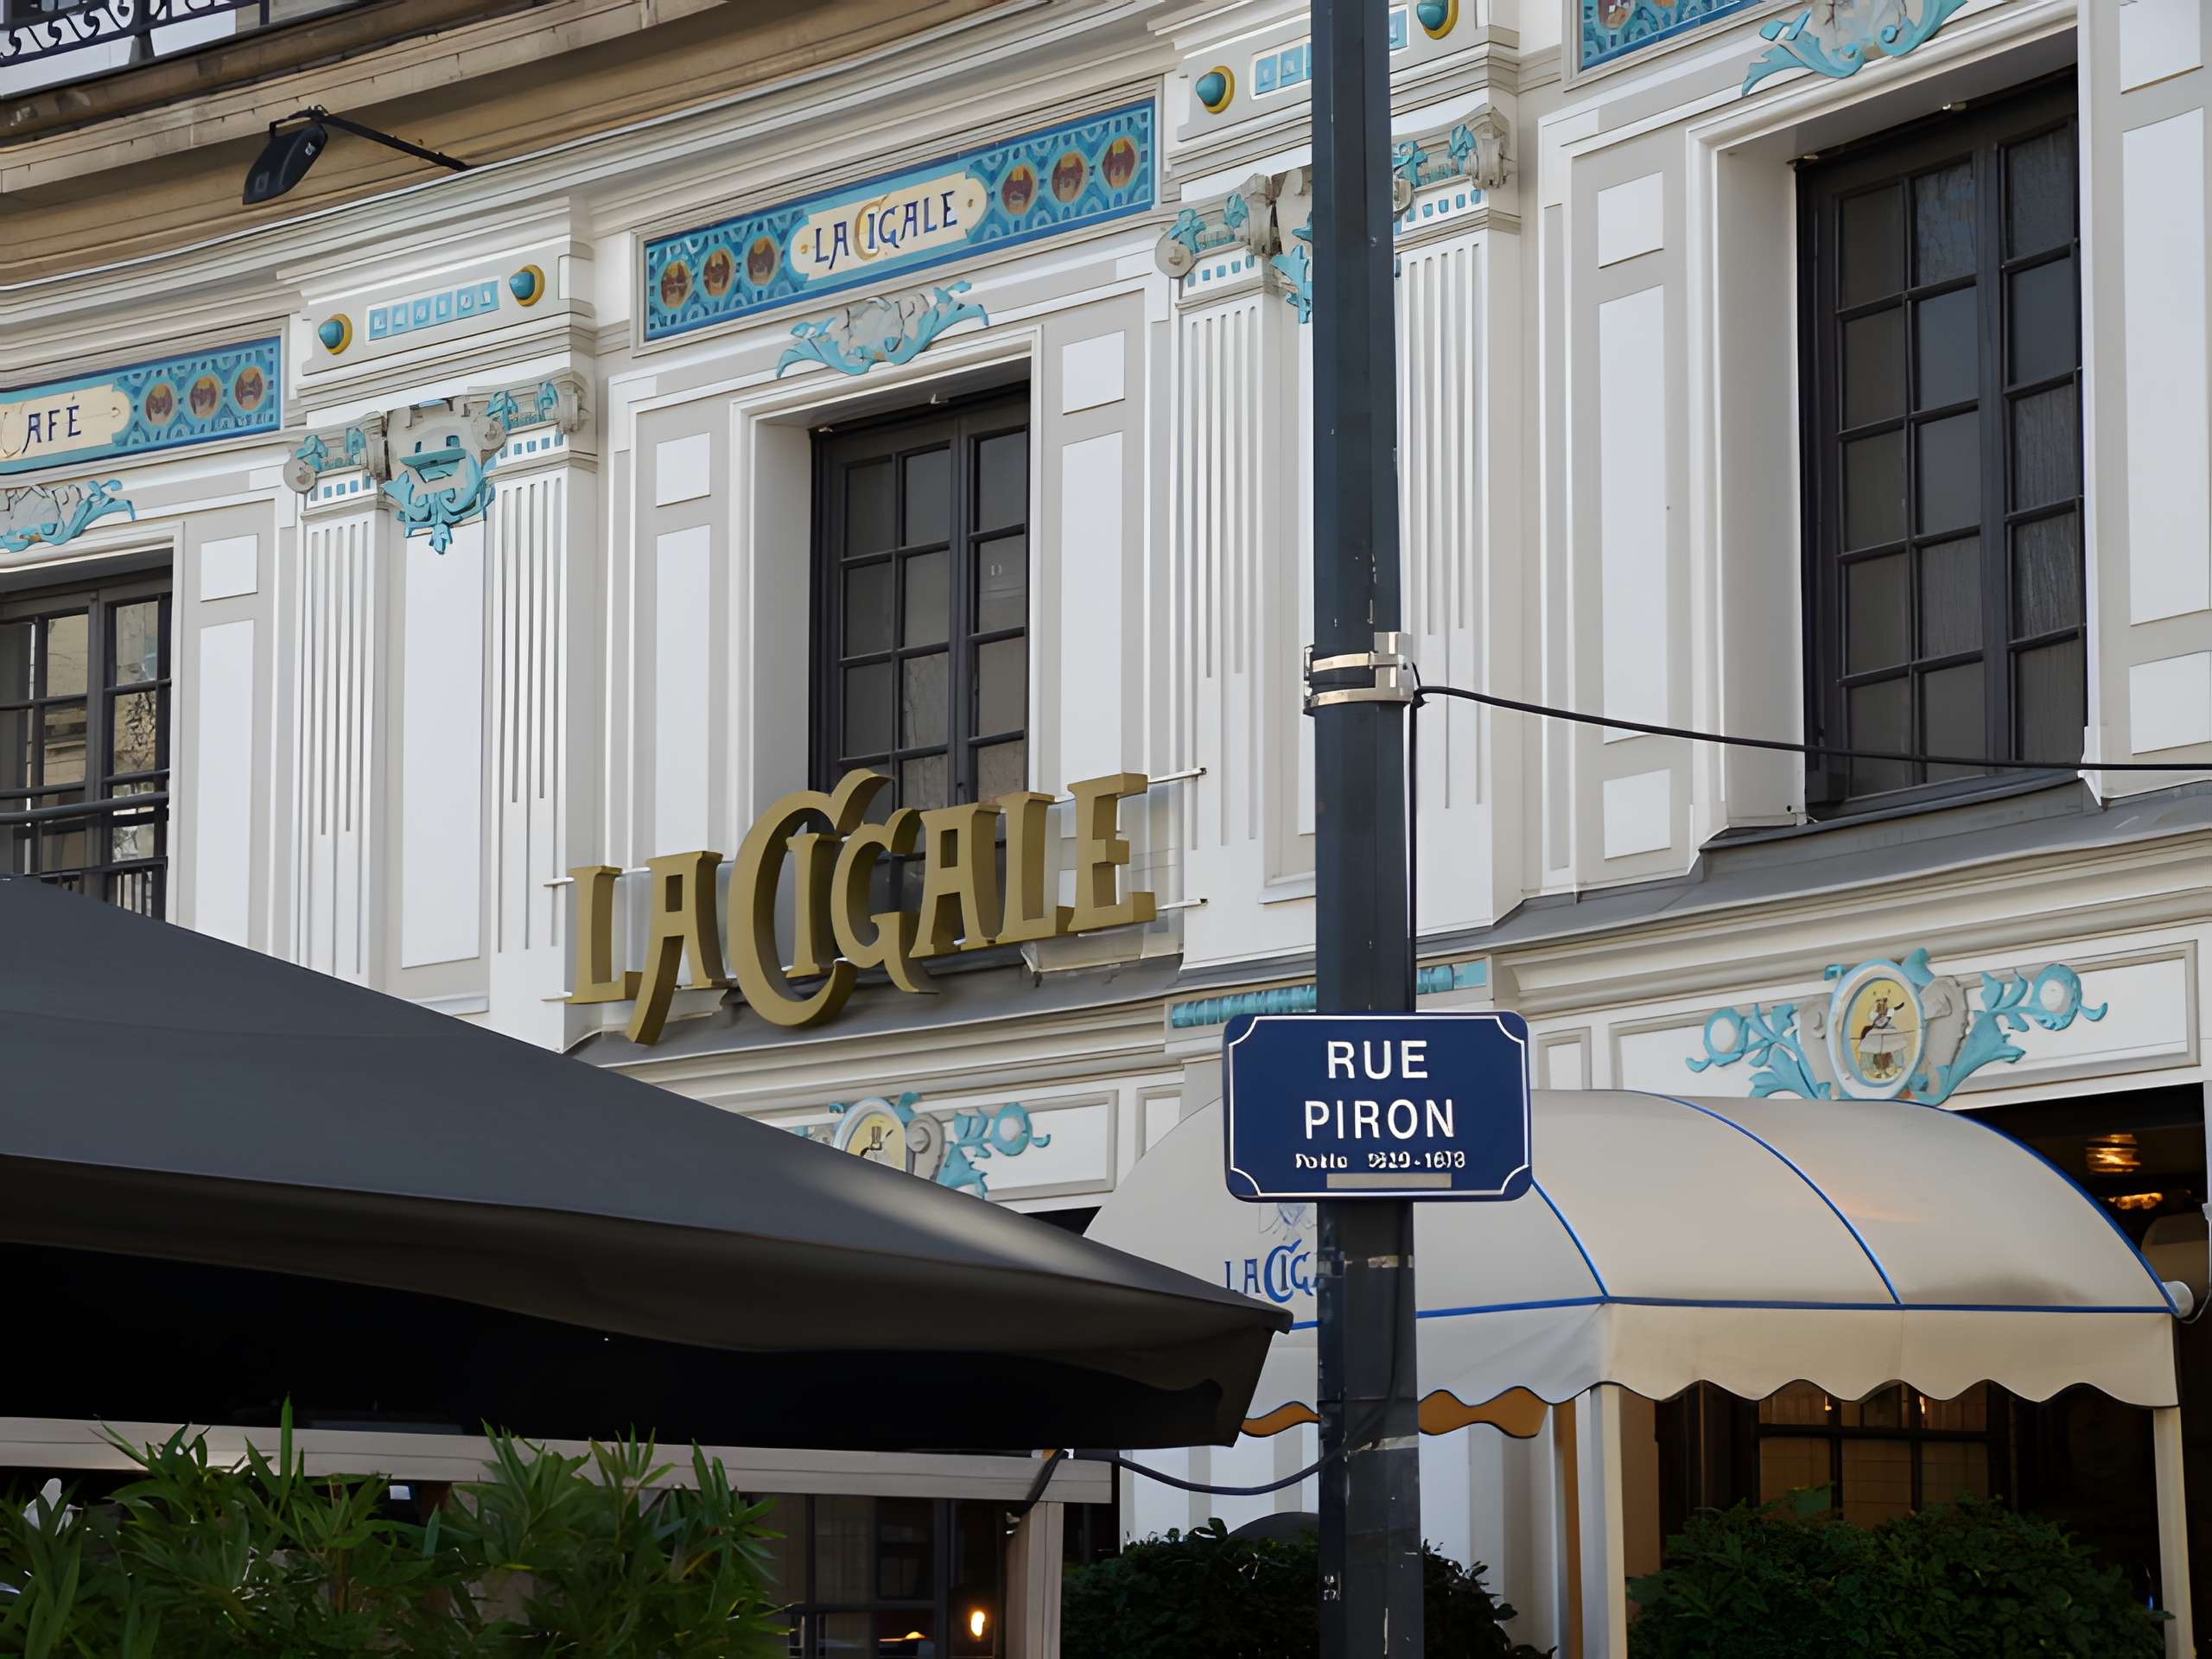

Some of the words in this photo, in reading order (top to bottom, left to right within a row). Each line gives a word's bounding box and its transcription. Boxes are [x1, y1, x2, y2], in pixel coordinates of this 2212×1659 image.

[815, 221, 849, 270] LA
[854, 189, 957, 261] CIGALE
[567, 850, 723, 1046] LA
[727, 768, 1156, 1027] CIGALE
[1327, 1039, 1428, 1079] RUE
[1305, 1099, 1454, 1140] PIRON
[1263, 1238, 1319, 1303] CIG
